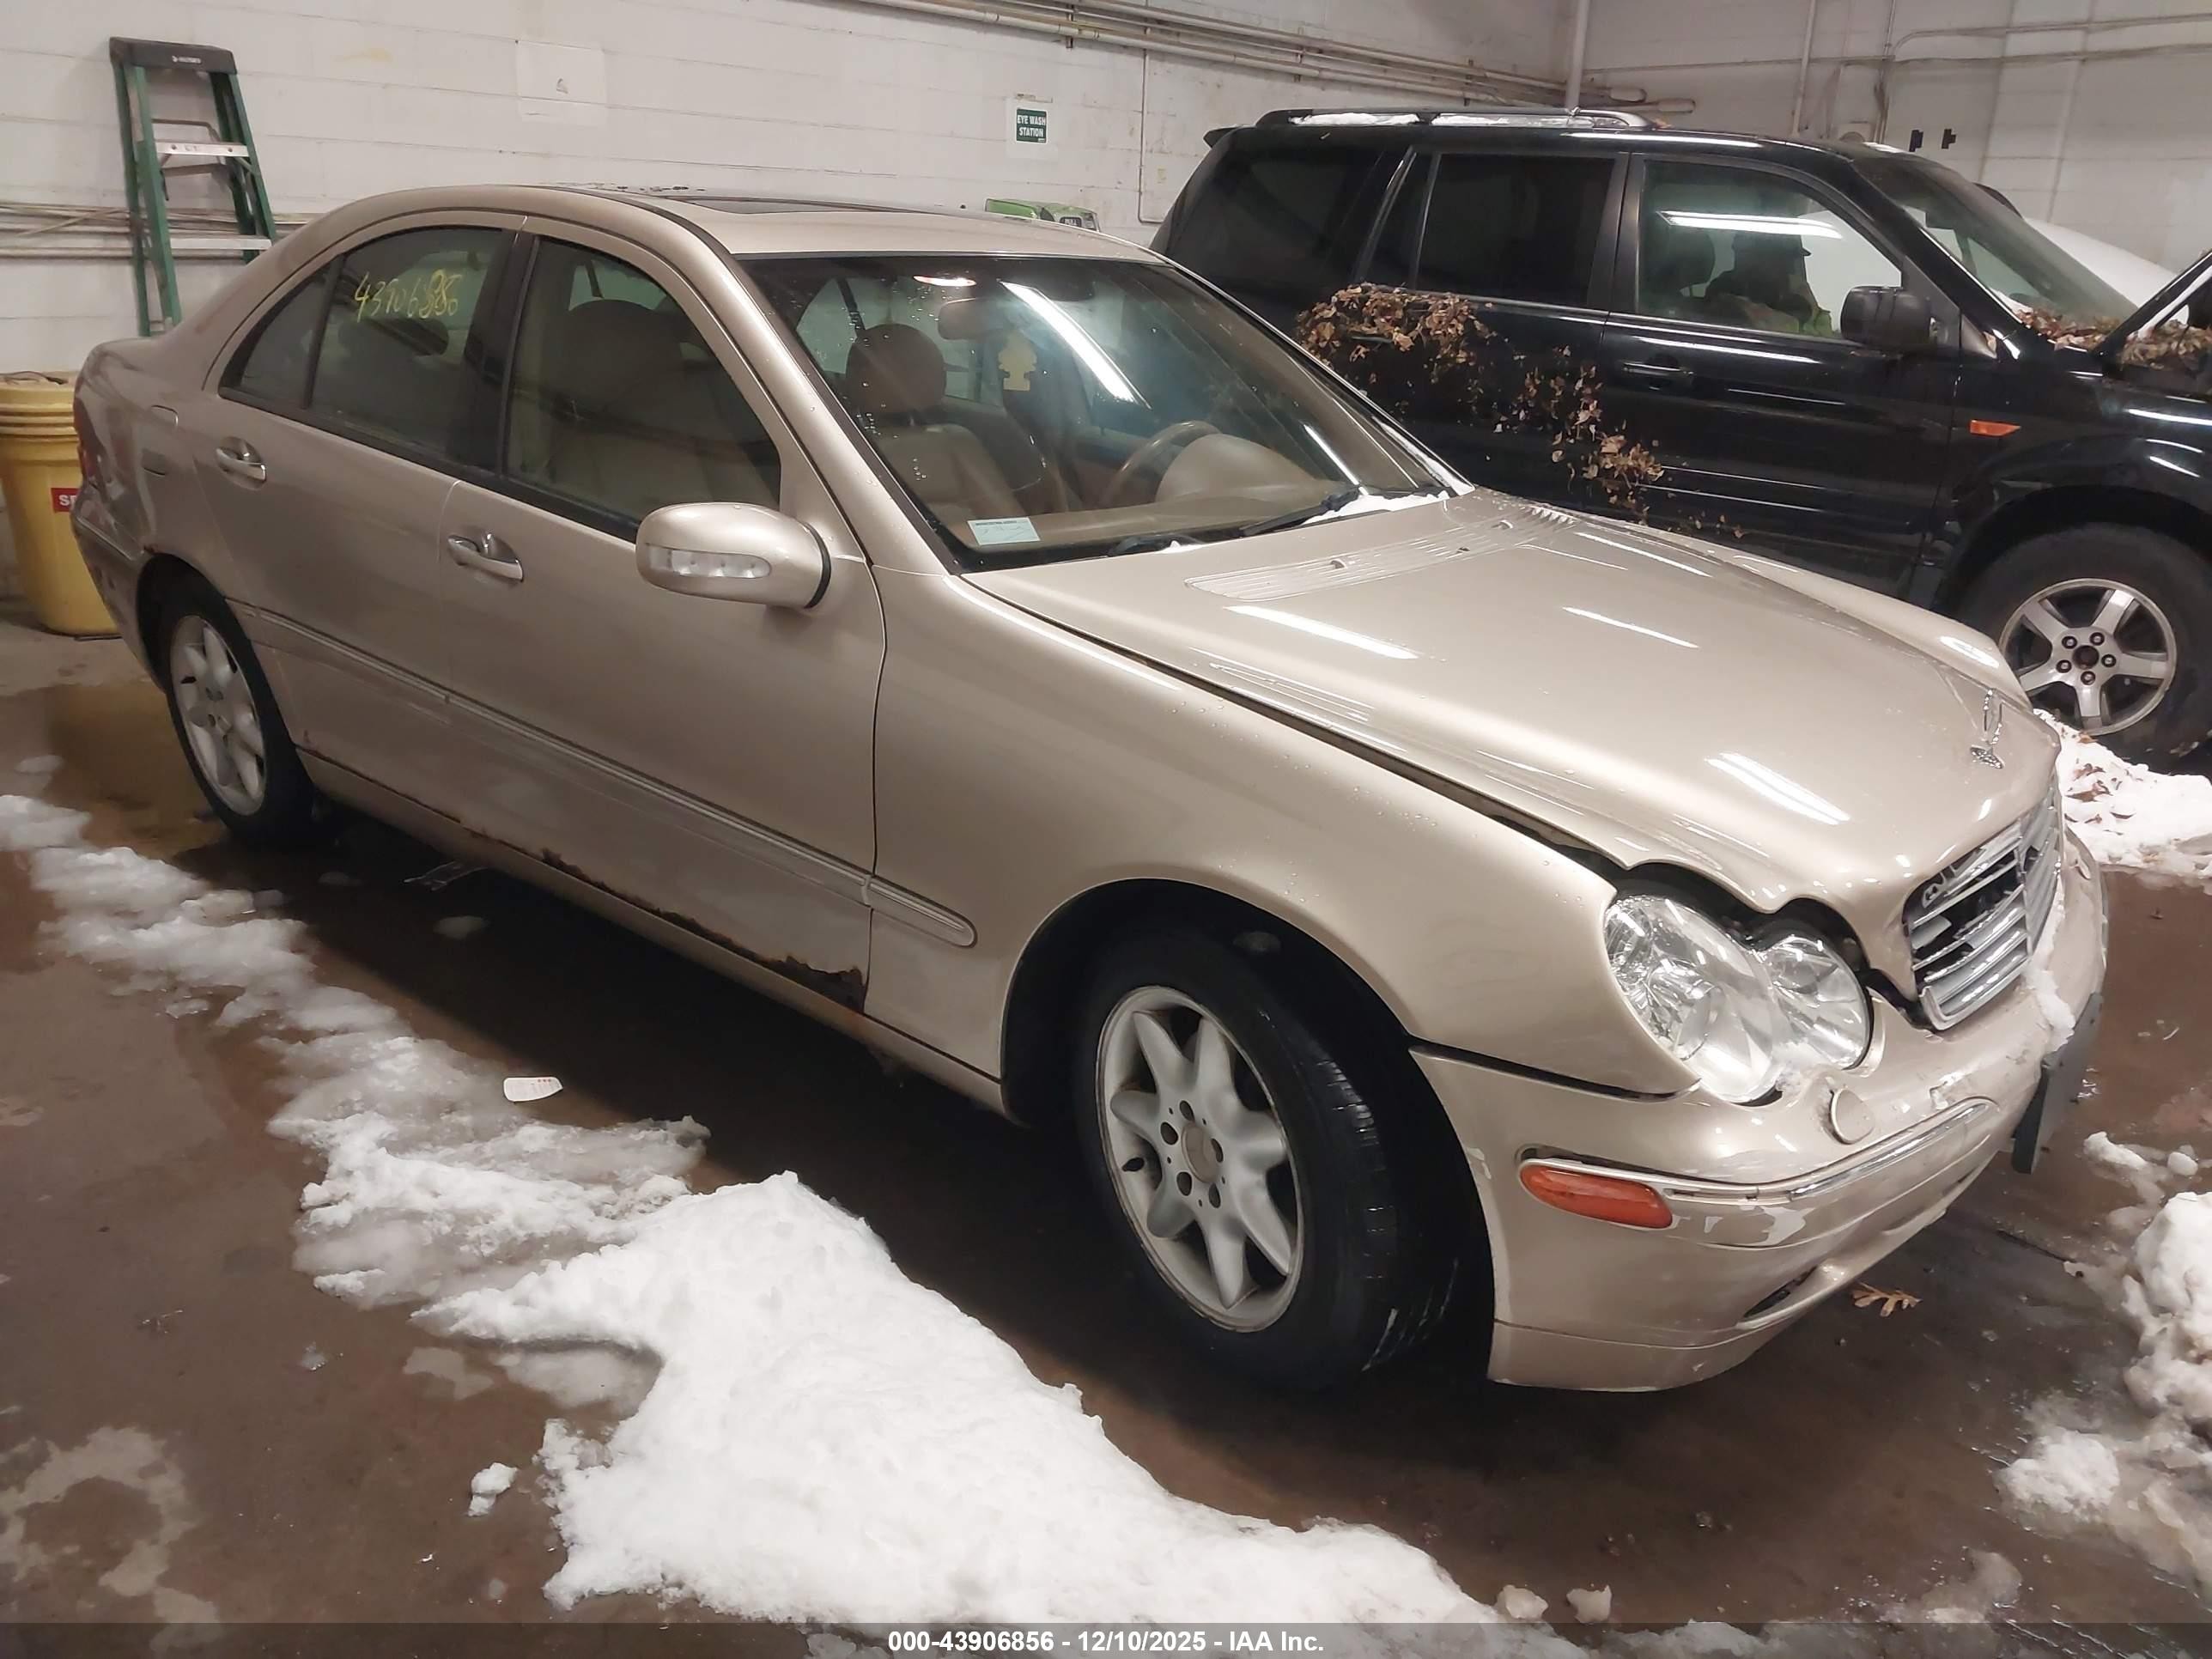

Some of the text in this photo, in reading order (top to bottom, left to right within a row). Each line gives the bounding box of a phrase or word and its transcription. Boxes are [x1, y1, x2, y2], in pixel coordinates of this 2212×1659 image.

[1017, 114, 1046, 126] EYE WASH
[1018, 126, 1044, 137] STATION
